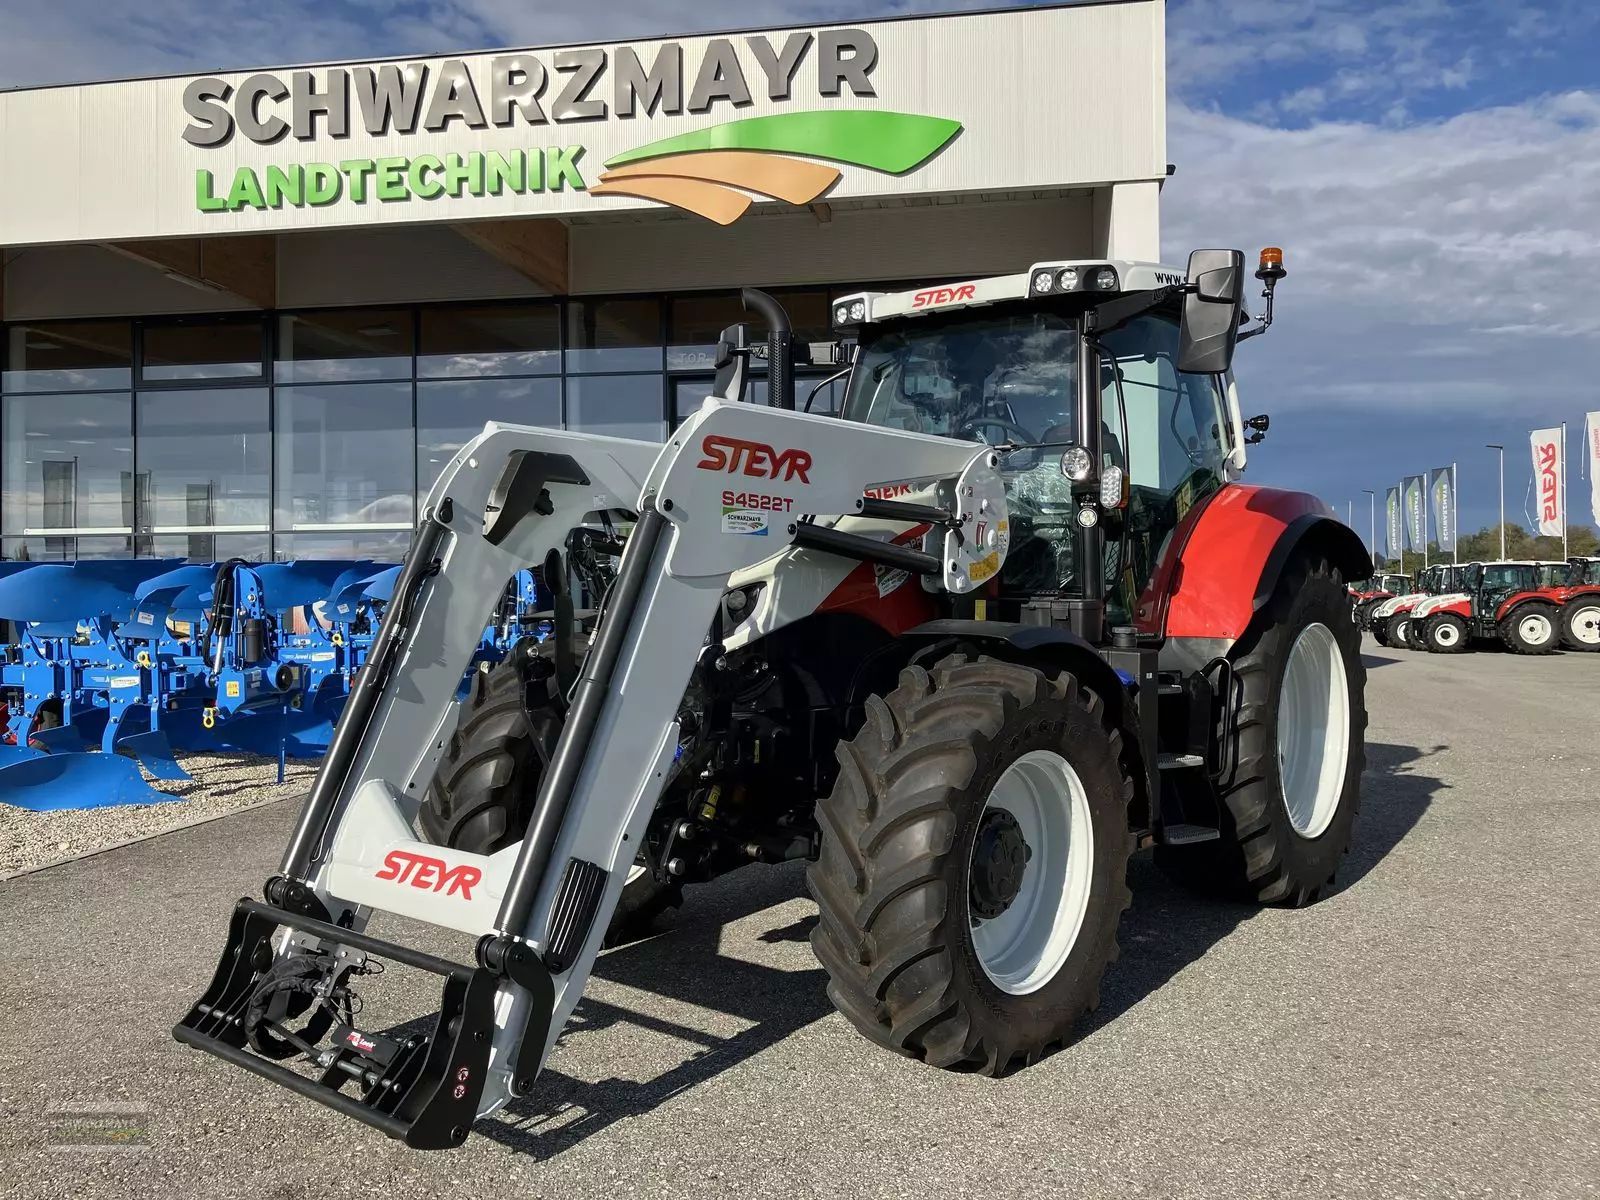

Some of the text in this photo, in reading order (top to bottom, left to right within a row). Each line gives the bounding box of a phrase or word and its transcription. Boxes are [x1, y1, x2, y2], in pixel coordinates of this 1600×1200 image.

[181, 28, 879, 148] SCHWARZMAYR
[196, 144, 590, 213] LANDTECHNIK
[911, 284, 976, 308] STEYR
[696, 434, 812, 485] STEYR
[722, 490, 794, 513] S4522T
[727, 514, 761, 522] SCHWARZMAYR
[375, 850, 482, 901] STEYR
